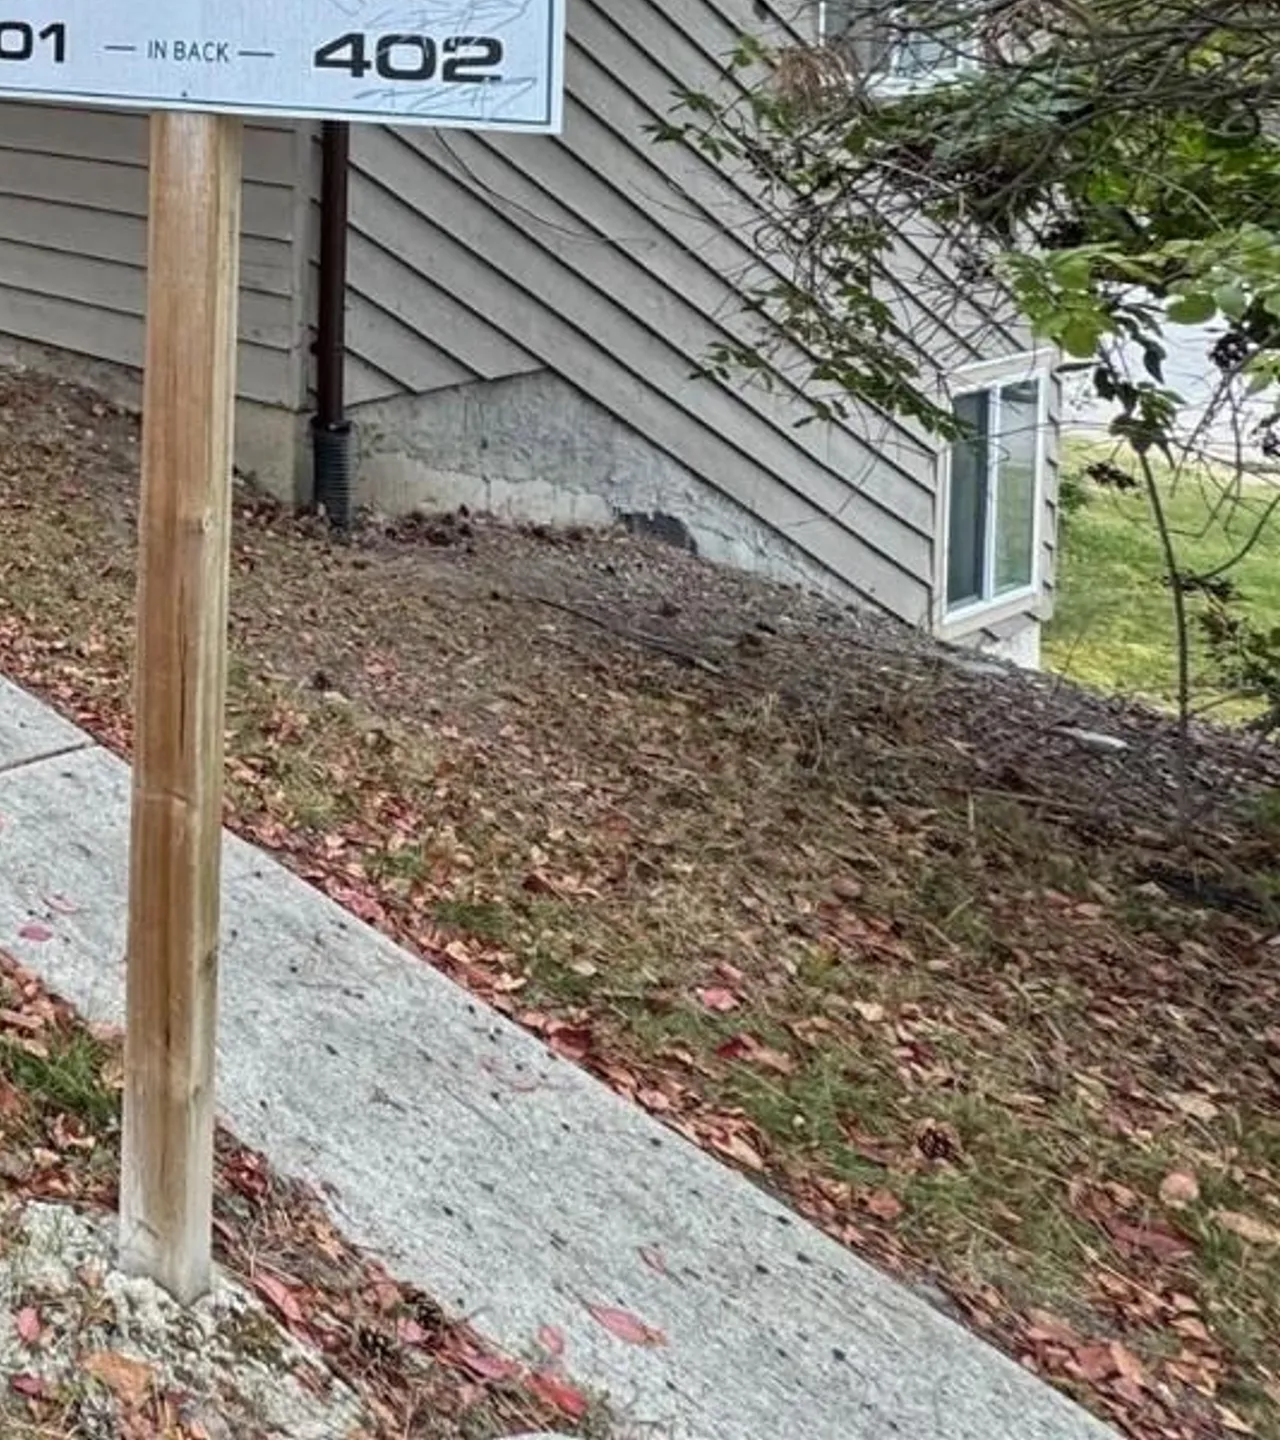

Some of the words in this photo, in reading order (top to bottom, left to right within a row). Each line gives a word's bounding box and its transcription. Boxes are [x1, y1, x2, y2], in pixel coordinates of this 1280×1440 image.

[147, 40, 167, 60] IN
[173, 41, 229, 62] BACK
[314, 32, 504, 83] 402
